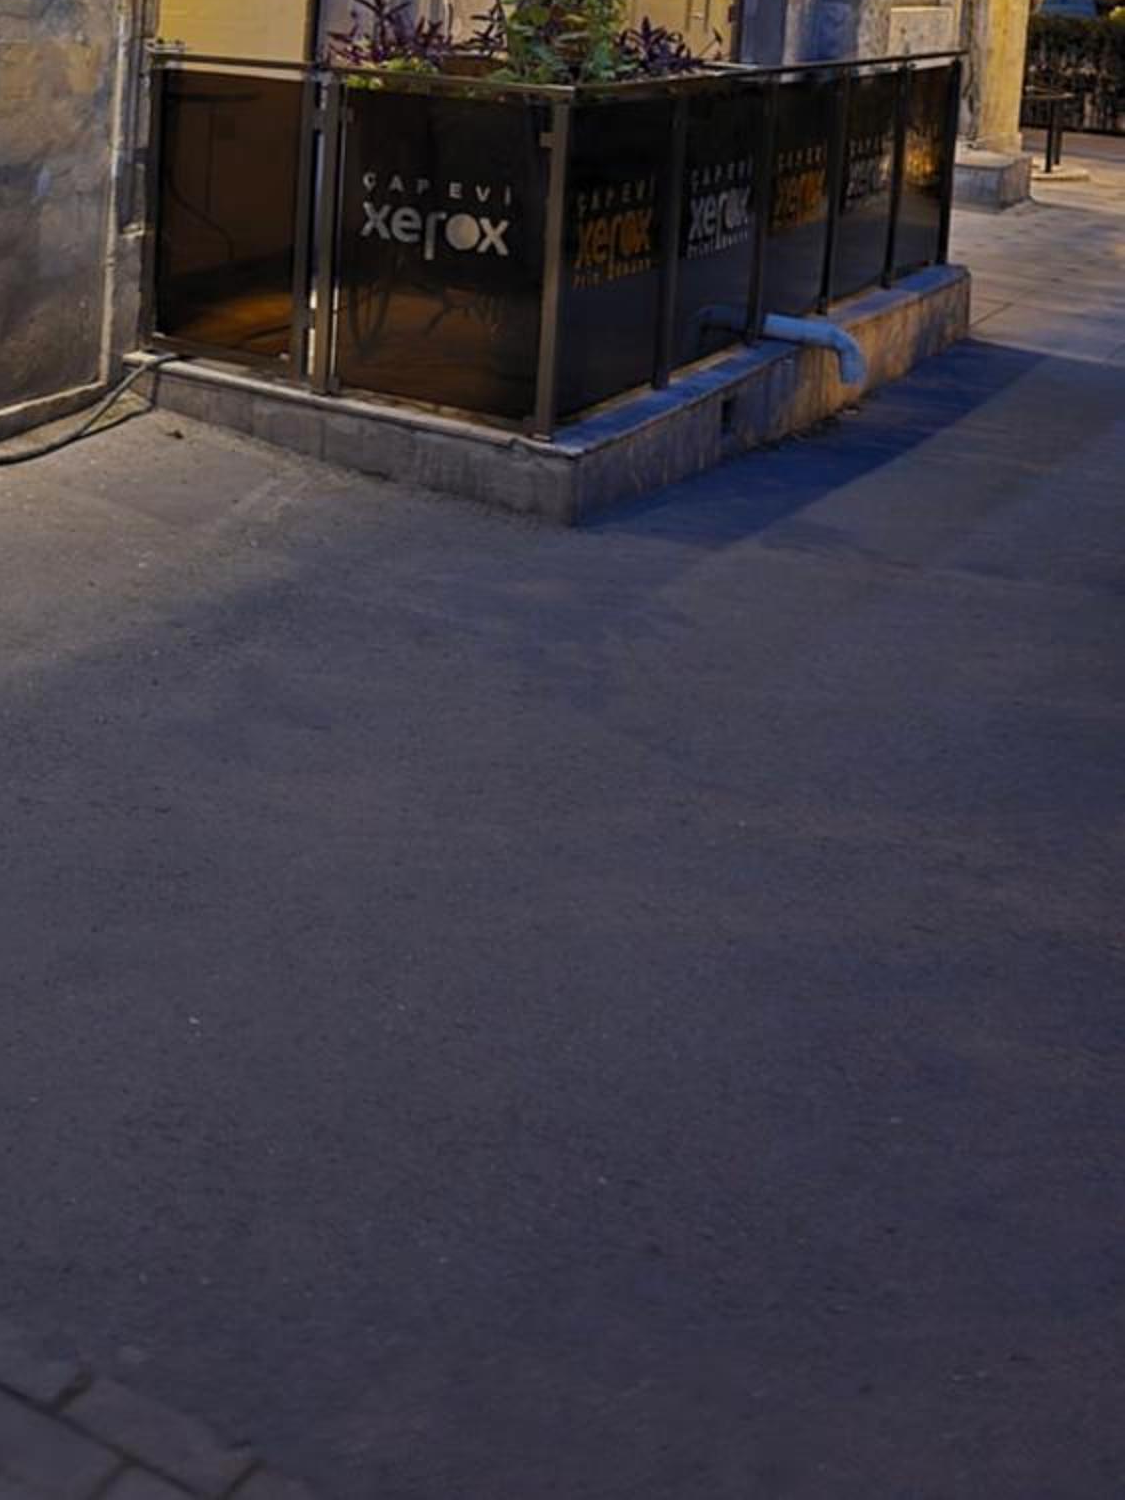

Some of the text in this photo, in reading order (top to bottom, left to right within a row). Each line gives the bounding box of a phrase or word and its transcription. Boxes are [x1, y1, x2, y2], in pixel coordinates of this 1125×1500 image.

[359, 201, 509, 260] xerox
[576, 207, 652, 281] xerox
[688, 185, 751, 250] xerox
